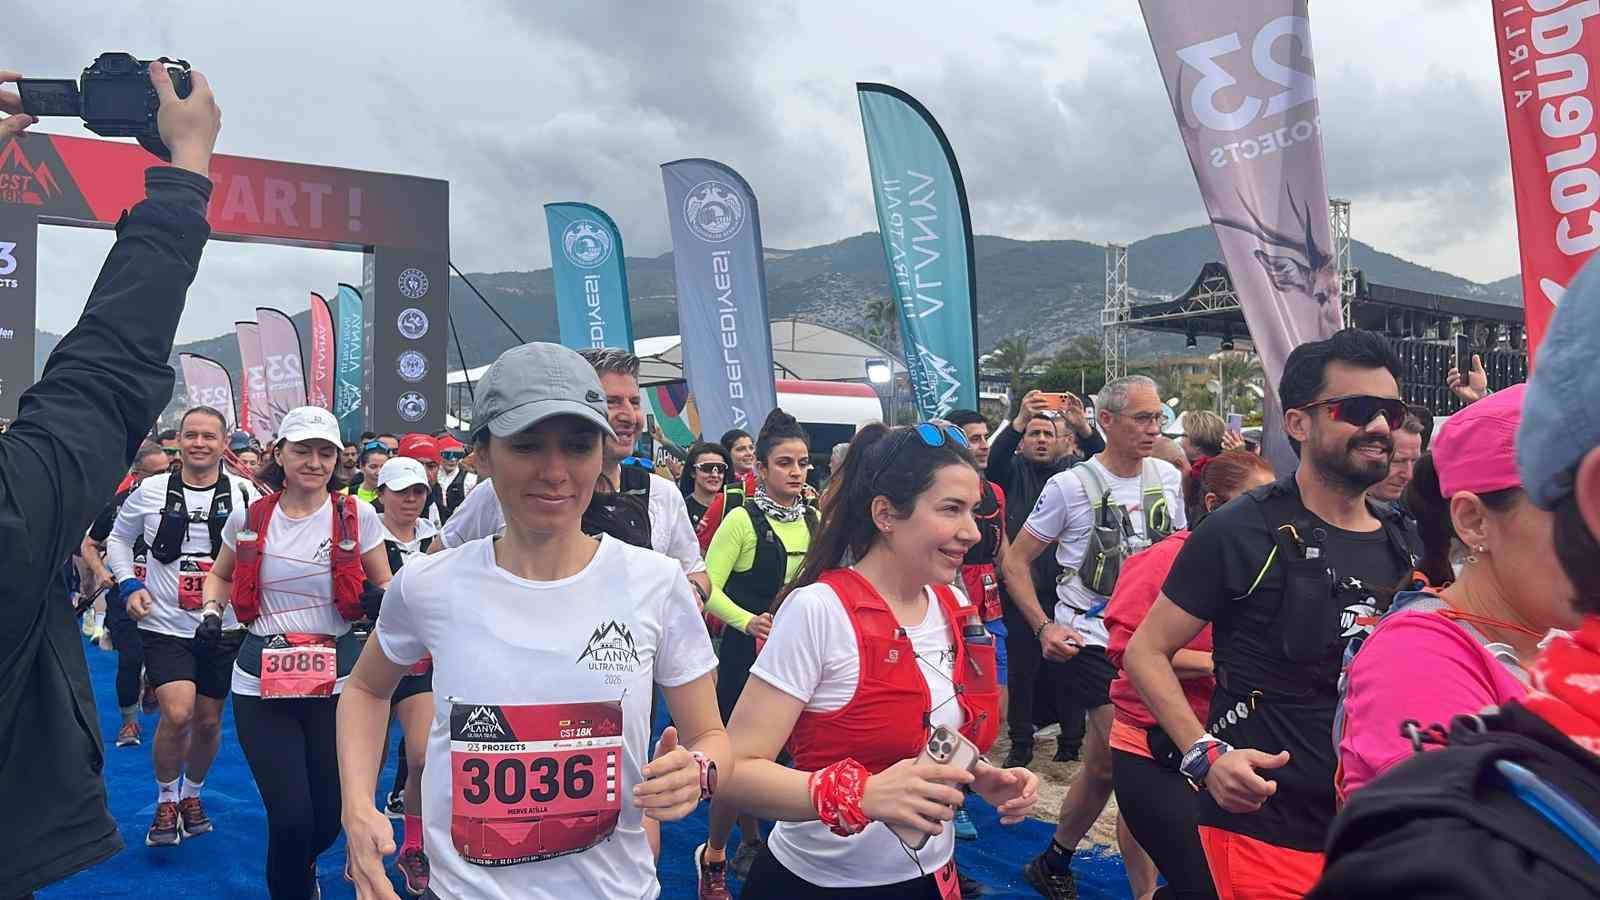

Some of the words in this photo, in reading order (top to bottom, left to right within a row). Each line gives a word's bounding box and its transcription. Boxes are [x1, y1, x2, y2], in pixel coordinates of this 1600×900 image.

[212, 172, 333, 228] ART
[266, 653, 326, 672] 3086
[576, 644, 640, 665] ALANYA
[588, 663, 614, 671] ULTRA
[616, 664, 634, 672] TRAIL
[466, 743, 480, 752] 23
[481, 743, 526, 752] PROJECTS
[463, 754, 594, 806] 3036
